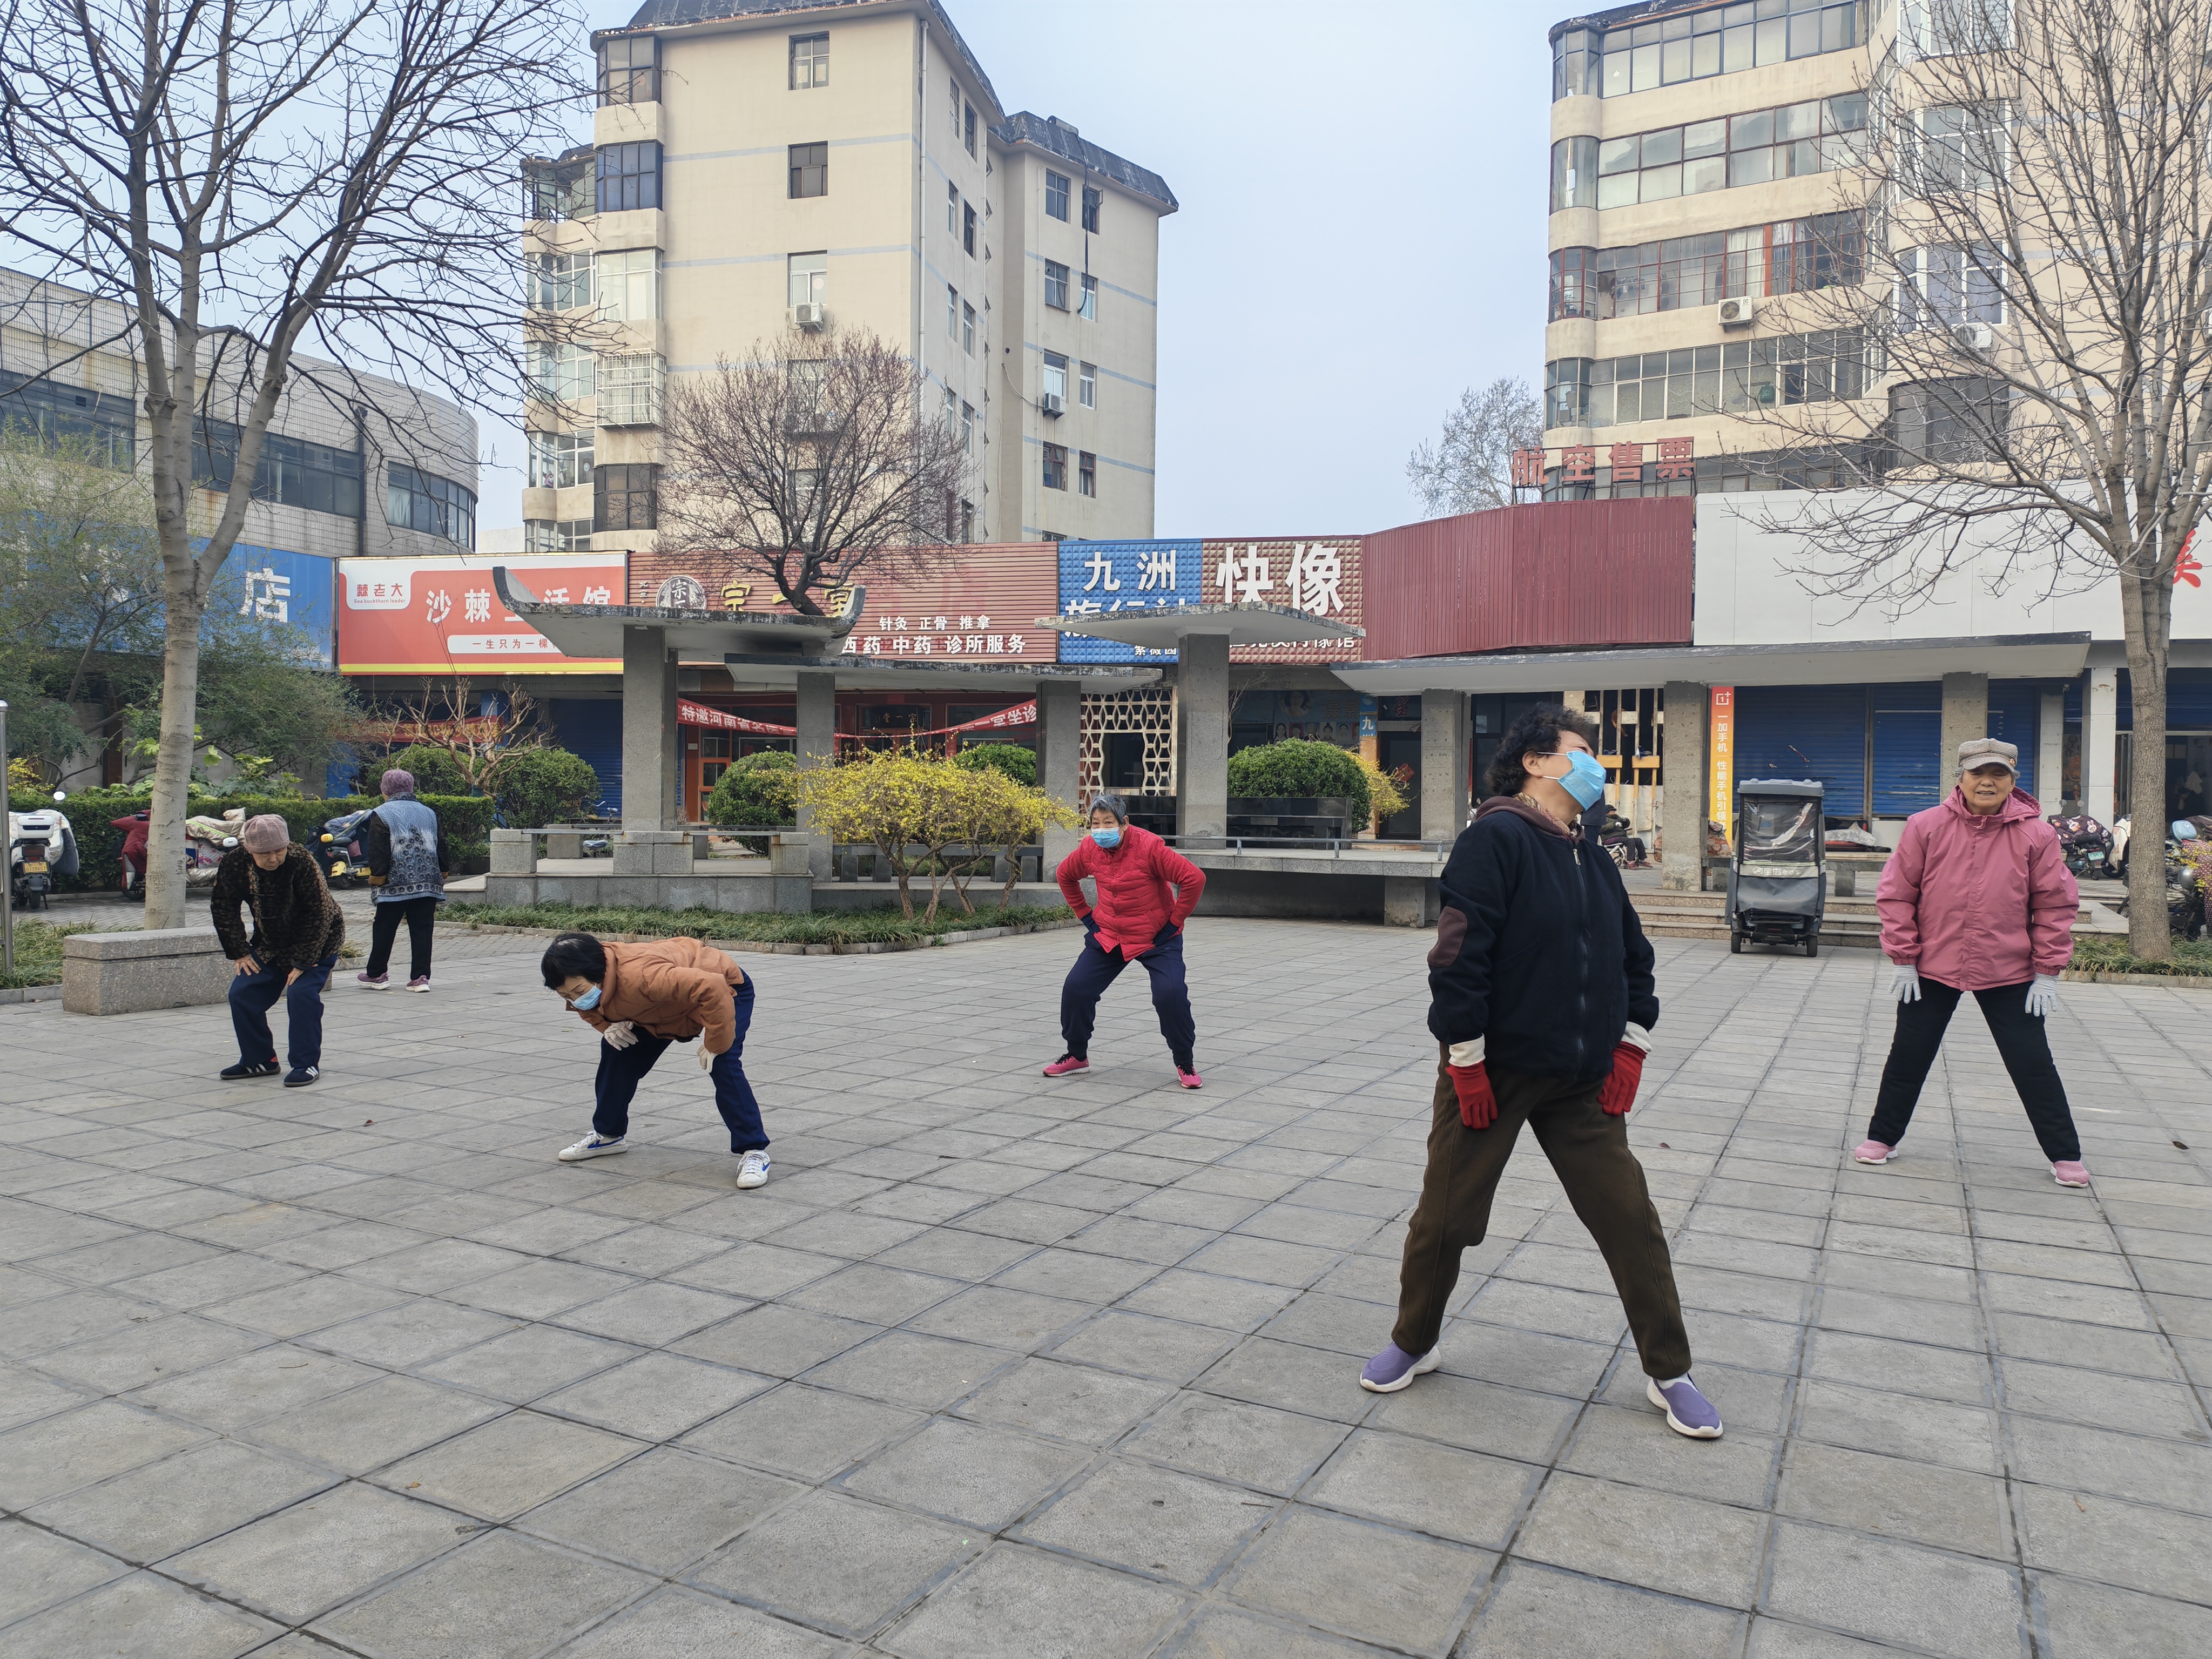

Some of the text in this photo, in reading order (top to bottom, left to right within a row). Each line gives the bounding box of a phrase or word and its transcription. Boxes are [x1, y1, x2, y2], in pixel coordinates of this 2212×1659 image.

[1512, 436, 1696, 485] 航空售票
[1083, 550, 1176, 592] 九洲
[1216, 543, 1345, 616] 快像
[356, 583, 403, 597] 棘老大
[879, 615, 991, 631] 针灸 正骨 推拿
[842, 633, 1026, 655] 西药 中药 诊所服务
